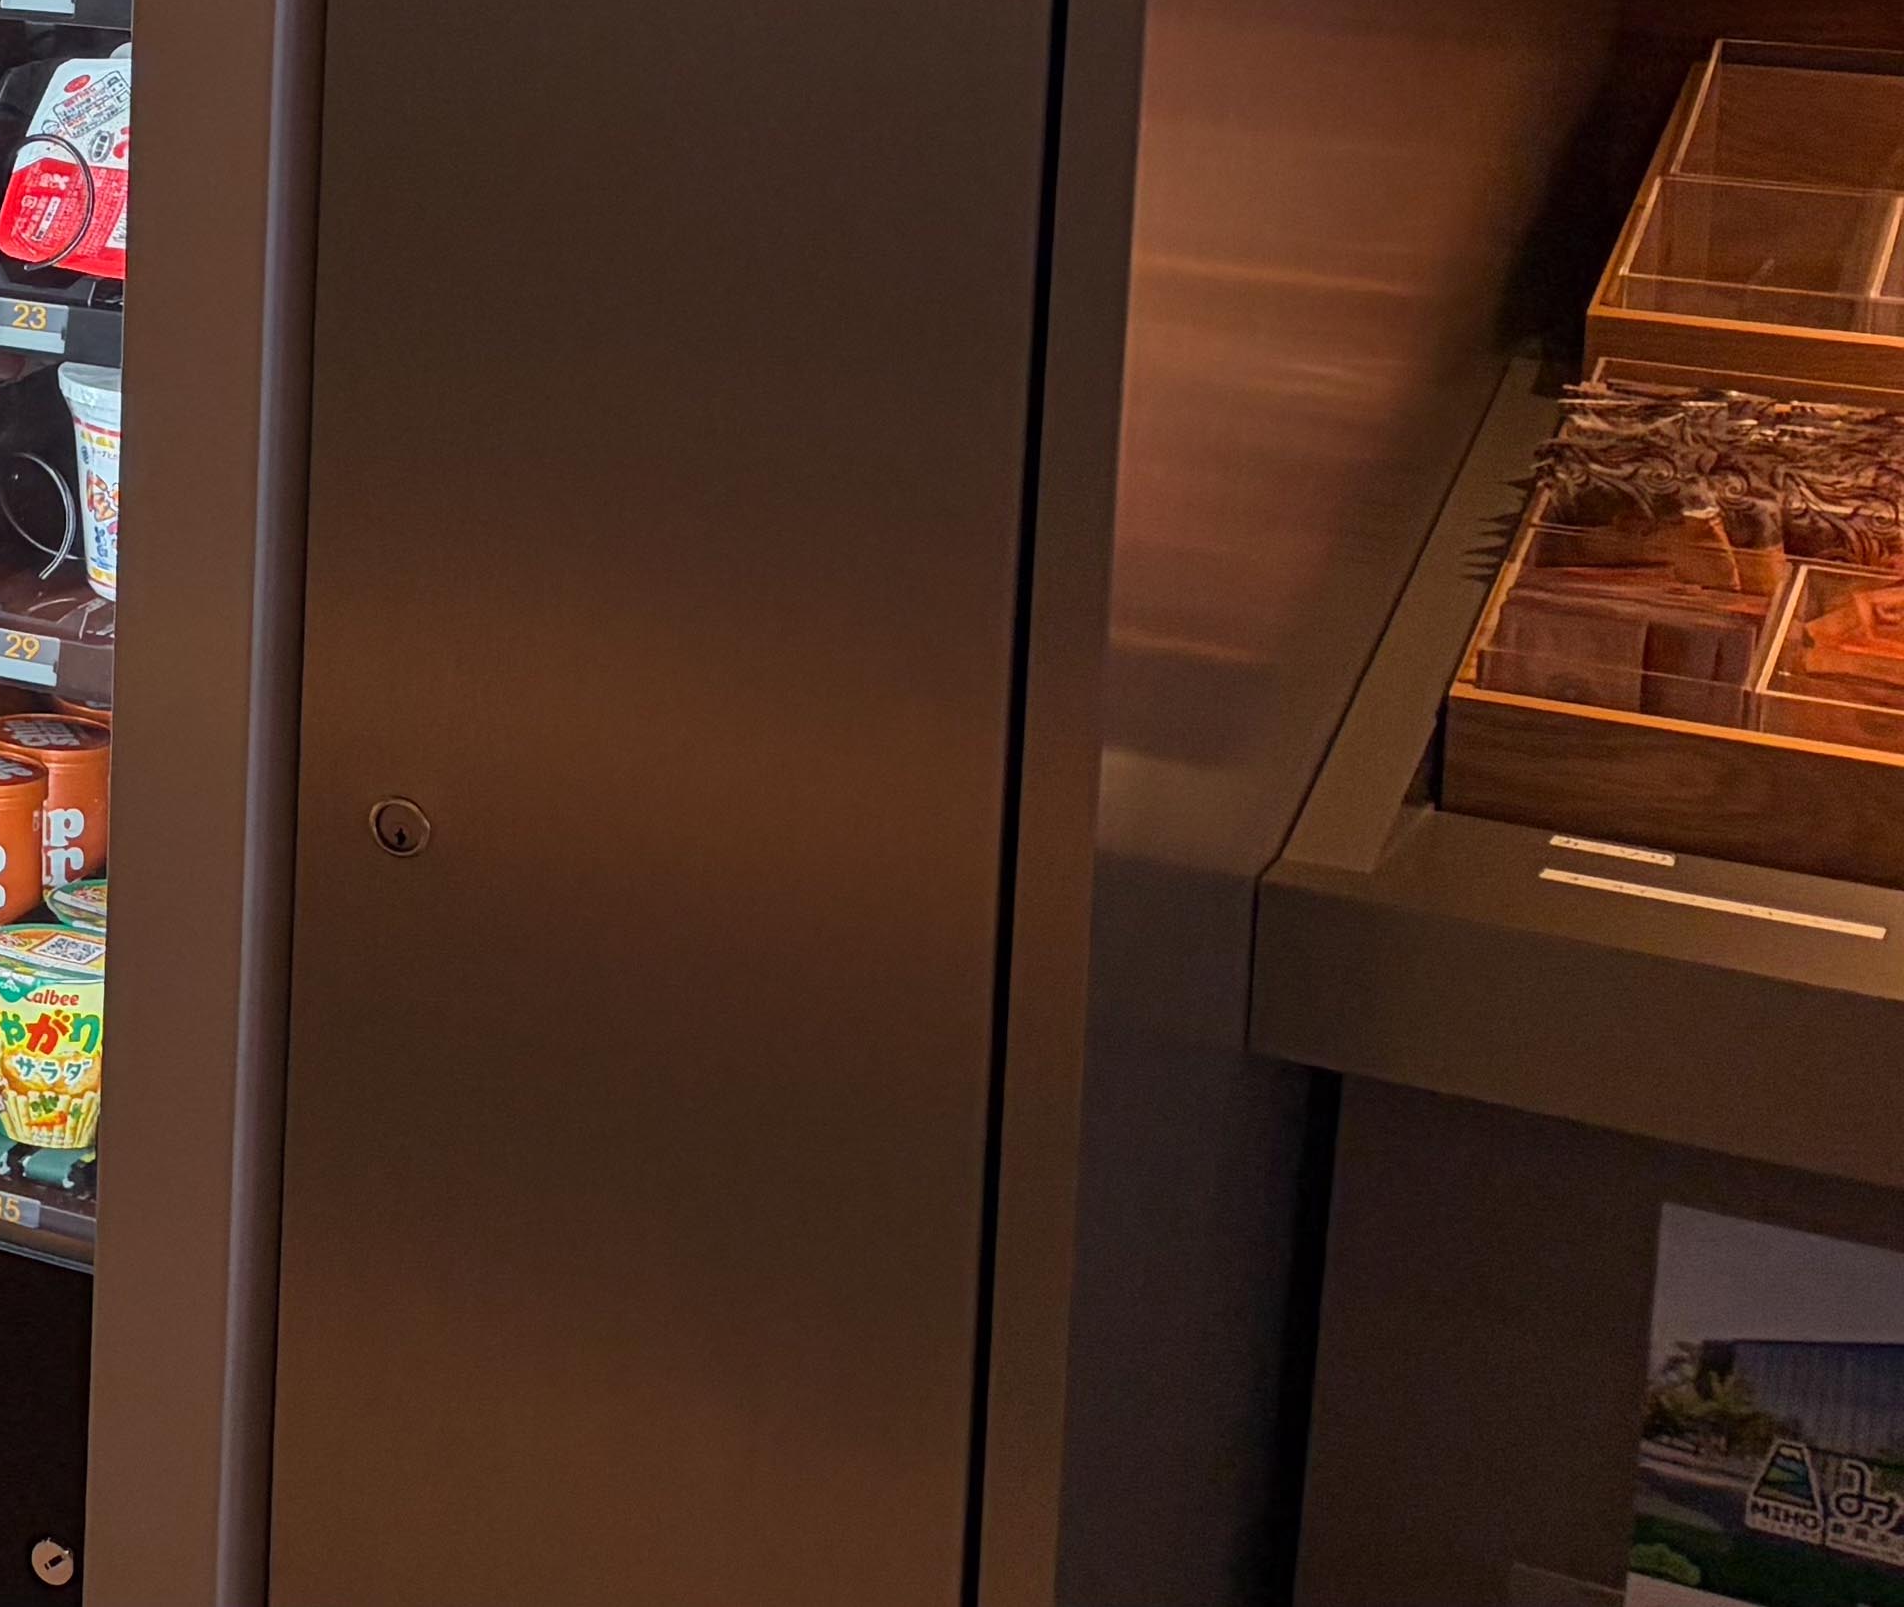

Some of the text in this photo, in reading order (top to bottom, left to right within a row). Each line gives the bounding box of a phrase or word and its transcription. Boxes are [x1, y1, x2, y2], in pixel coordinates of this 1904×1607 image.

[12, 304, 48, 331] 23
[4, 633, 41, 661] 29
[26, 988, 80, 1007] Calbee
[15, 1056, 91, 1084] サラダ
